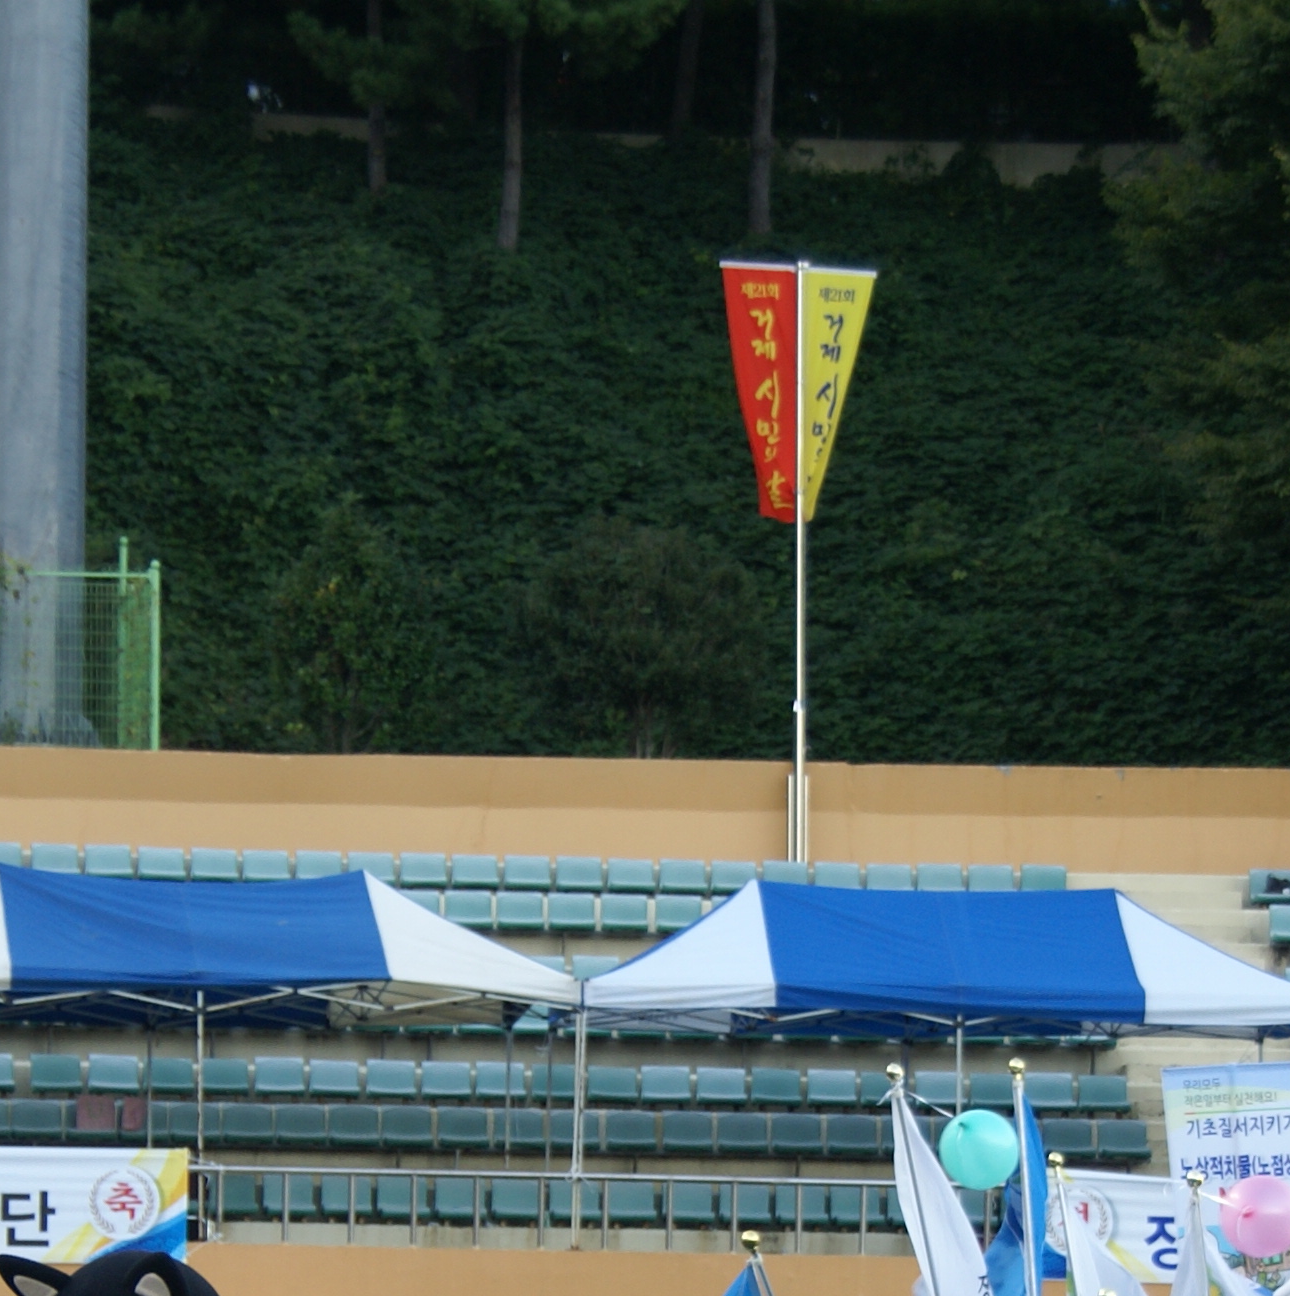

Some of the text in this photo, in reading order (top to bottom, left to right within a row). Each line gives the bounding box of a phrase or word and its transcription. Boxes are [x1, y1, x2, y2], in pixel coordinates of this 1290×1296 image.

[741, 281, 781, 300] 제21회
[819, 286, 856, 304] 제21회
[1182, 1077, 1221, 1090] 우리모두
[103, 1181, 142, 1221] 축
